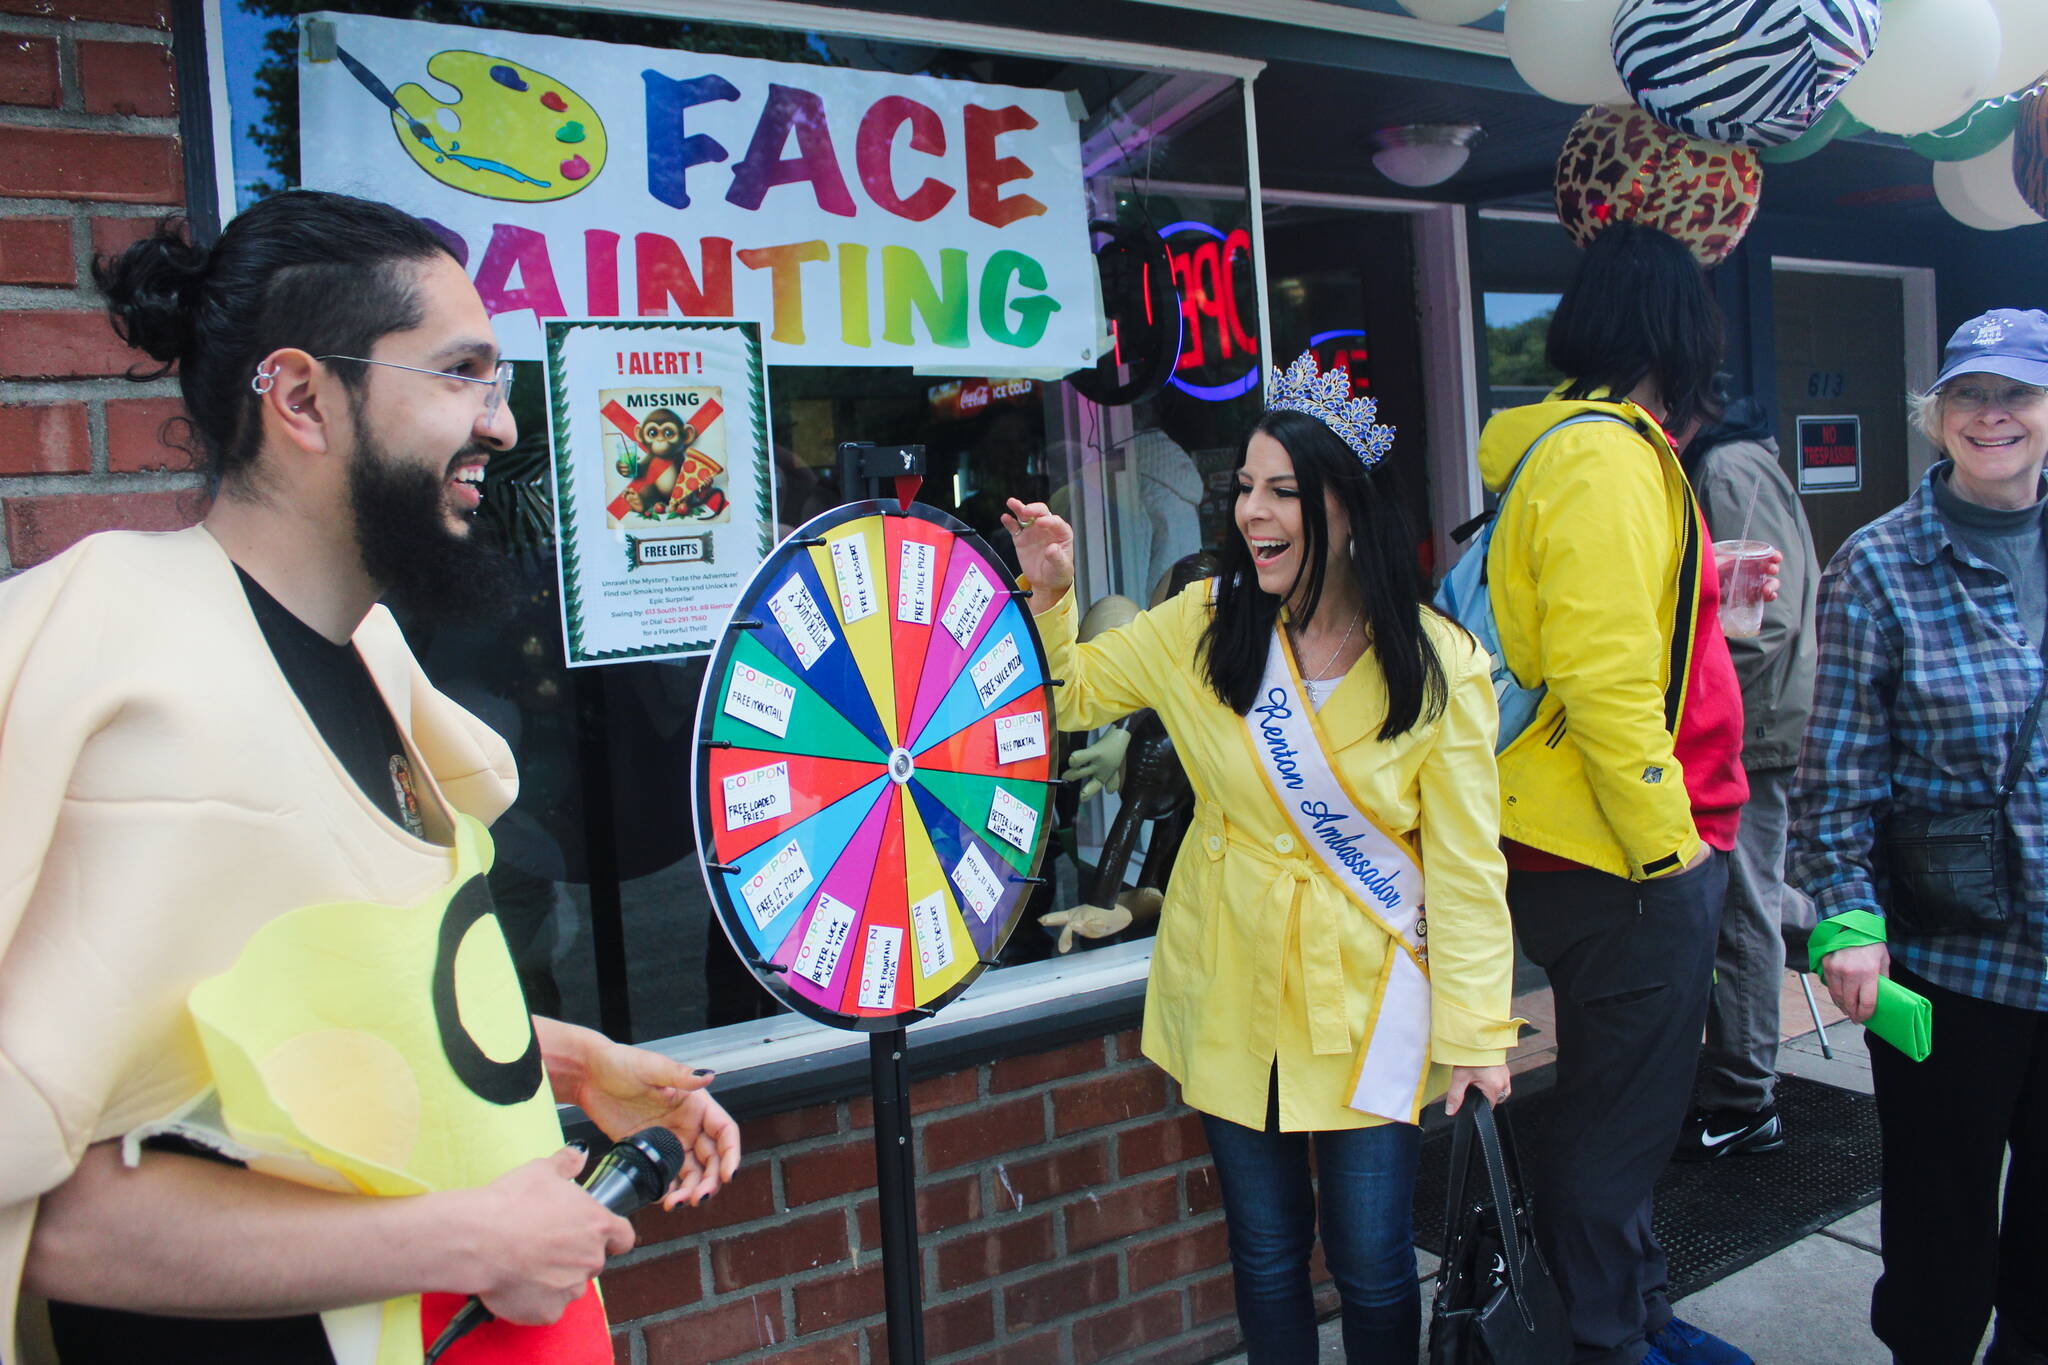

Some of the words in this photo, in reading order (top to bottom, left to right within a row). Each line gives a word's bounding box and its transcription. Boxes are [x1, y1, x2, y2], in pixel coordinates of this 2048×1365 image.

[641, 67, 1048, 229] FACE
[629, 351, 691, 375] ALERT
[992, 385, 1006, 399] ICE
[1008, 380, 1032, 396] COLD
[1808, 372, 1844, 397] 613
[626, 391, 700, 408] MISSING
[1822, 425, 1836, 443] NO
[1803, 446, 1856, 465] TRESPASSING
[644, 545, 668, 558] FREE
[670, 543, 698, 556] GIFTS
[848, 543, 864, 585] DESSERT
[917, 545, 926, 569] PIZZA
[833, 544, 853, 620] COUPON
[900, 543, 911, 618] COUPON
[799, 585, 814, 610] TIME
[859, 588, 869, 614] FREE
[943, 566, 977, 625] COUPON
[794, 597, 813, 625] LUCK
[813, 610, 829, 632] NEXT
[914, 598, 925, 621] FREE
[954, 607, 972, 642] BETTER
[968, 584, 983, 610] LUCK
[966, 613, 979, 636] NEXT
[976, 595, 990, 613] TIME
[659, 626, 688, 635] Flavorful
[769, 599, 812, 665] COUPON
[806, 621, 829, 652] BETTER
[736, 665, 794, 700] COUPON
[979, 678, 996, 702] FREE
[1007, 654, 1022, 674] PIZZA
[731, 690, 751, 707] FREE
[751, 699, 784, 722] MOCKTAIL
[998, 713, 1041, 730] COUPON
[1000, 740, 1013, 752] FREE
[1254, 687, 1304, 790] Renton
[726, 764, 785, 790] COUPON
[728, 803, 749, 819] FREE
[750, 794, 776, 812] LOADED
[742, 810, 765, 824] FRIES
[991, 809, 1009, 829] BETTER
[1009, 832, 1022, 846] TIME
[744, 843, 798, 896] COUPON
[967, 856, 980, 875] PIZZA
[1300, 801, 1401, 911] Ambassador
[756, 894, 774, 917] FREE
[784, 867, 805, 890] PIZZA
[768, 891, 794, 918] CHEESE
[985, 883, 999, 903] FREE
[797, 896, 831, 971] COUPON
[930, 905, 943, 941] DESSERT
[812, 947, 830, 982] BETTER
[825, 917, 839, 945] LUCK
[825, 951, 838, 978] NEXT
[835, 920, 849, 946] TIME
[914, 905, 932, 974] COUPON
[861, 928, 878, 1004] COUPON
[881, 940, 891, 980] FOUNTAIN
[936, 942, 947, 966] FREE
[887, 960, 897, 989] SODA
[878, 982, 887, 1005] FREE
